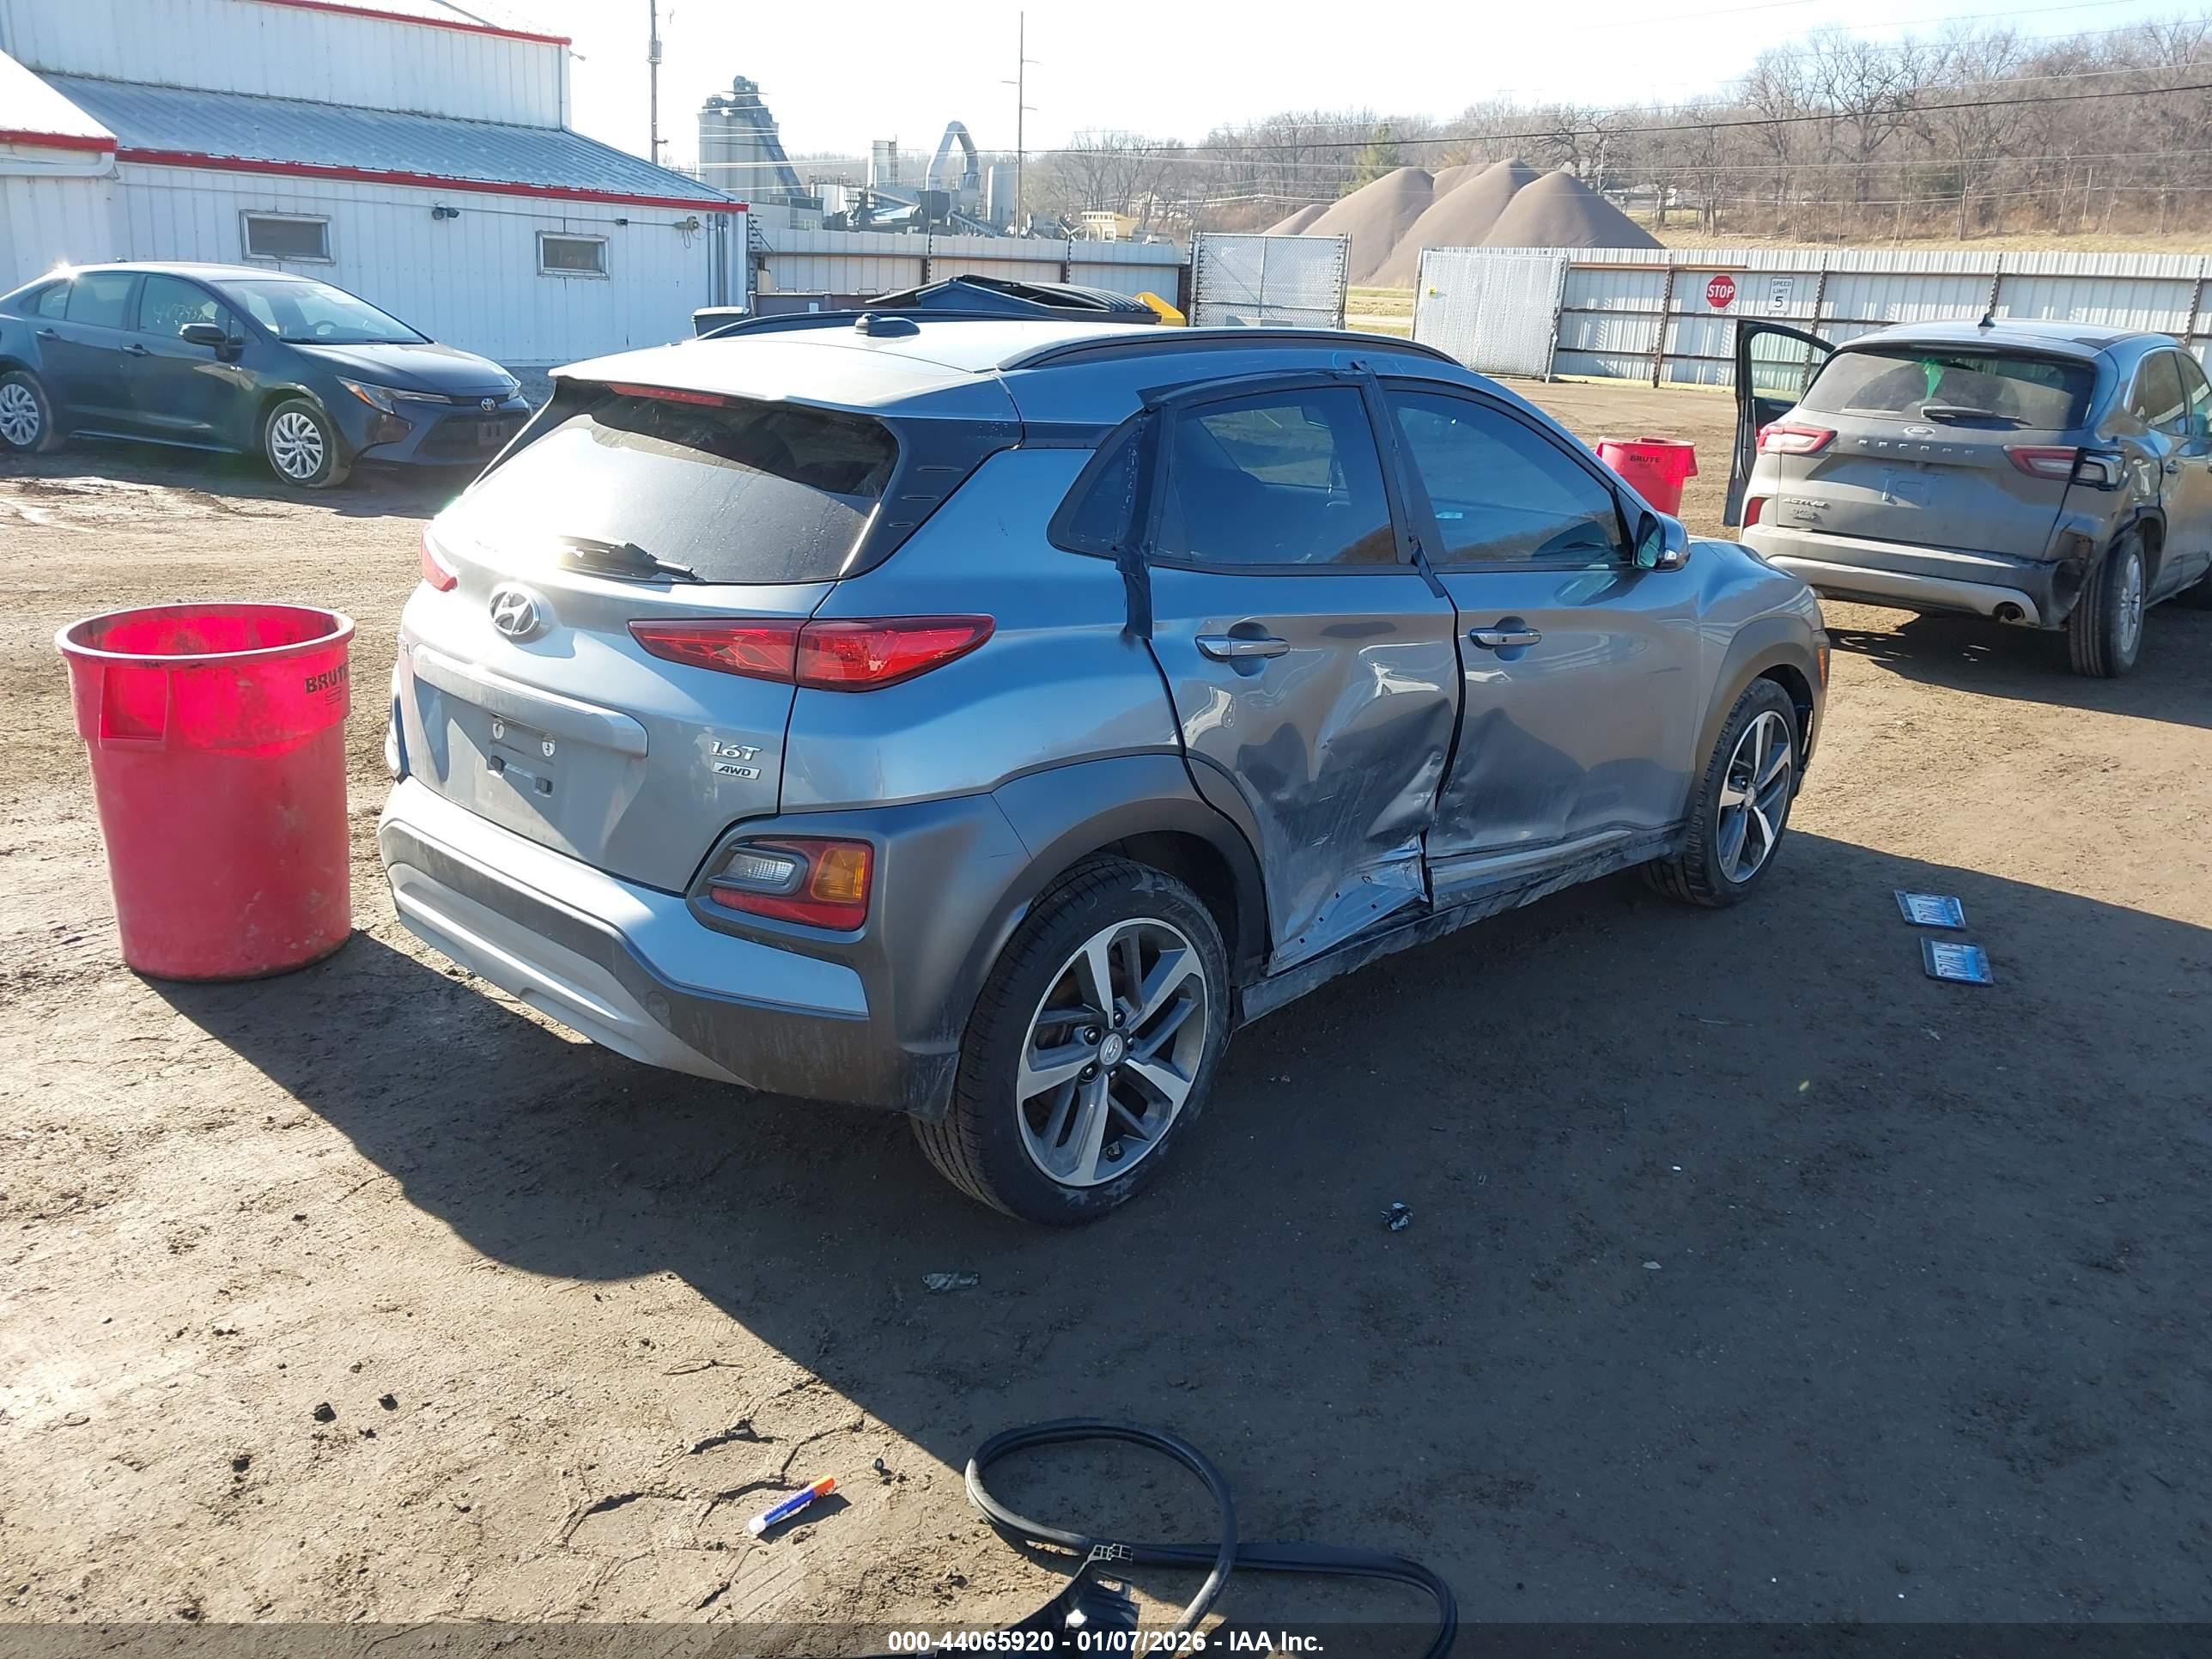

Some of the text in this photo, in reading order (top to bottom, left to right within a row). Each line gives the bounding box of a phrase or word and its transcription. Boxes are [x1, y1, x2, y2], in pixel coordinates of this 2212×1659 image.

[1707, 284, 1735, 298] STOP
[1774, 295, 1784, 308] 5
[1630, 454, 1662, 463] BRUTE
[718, 765, 751, 776] AWD
